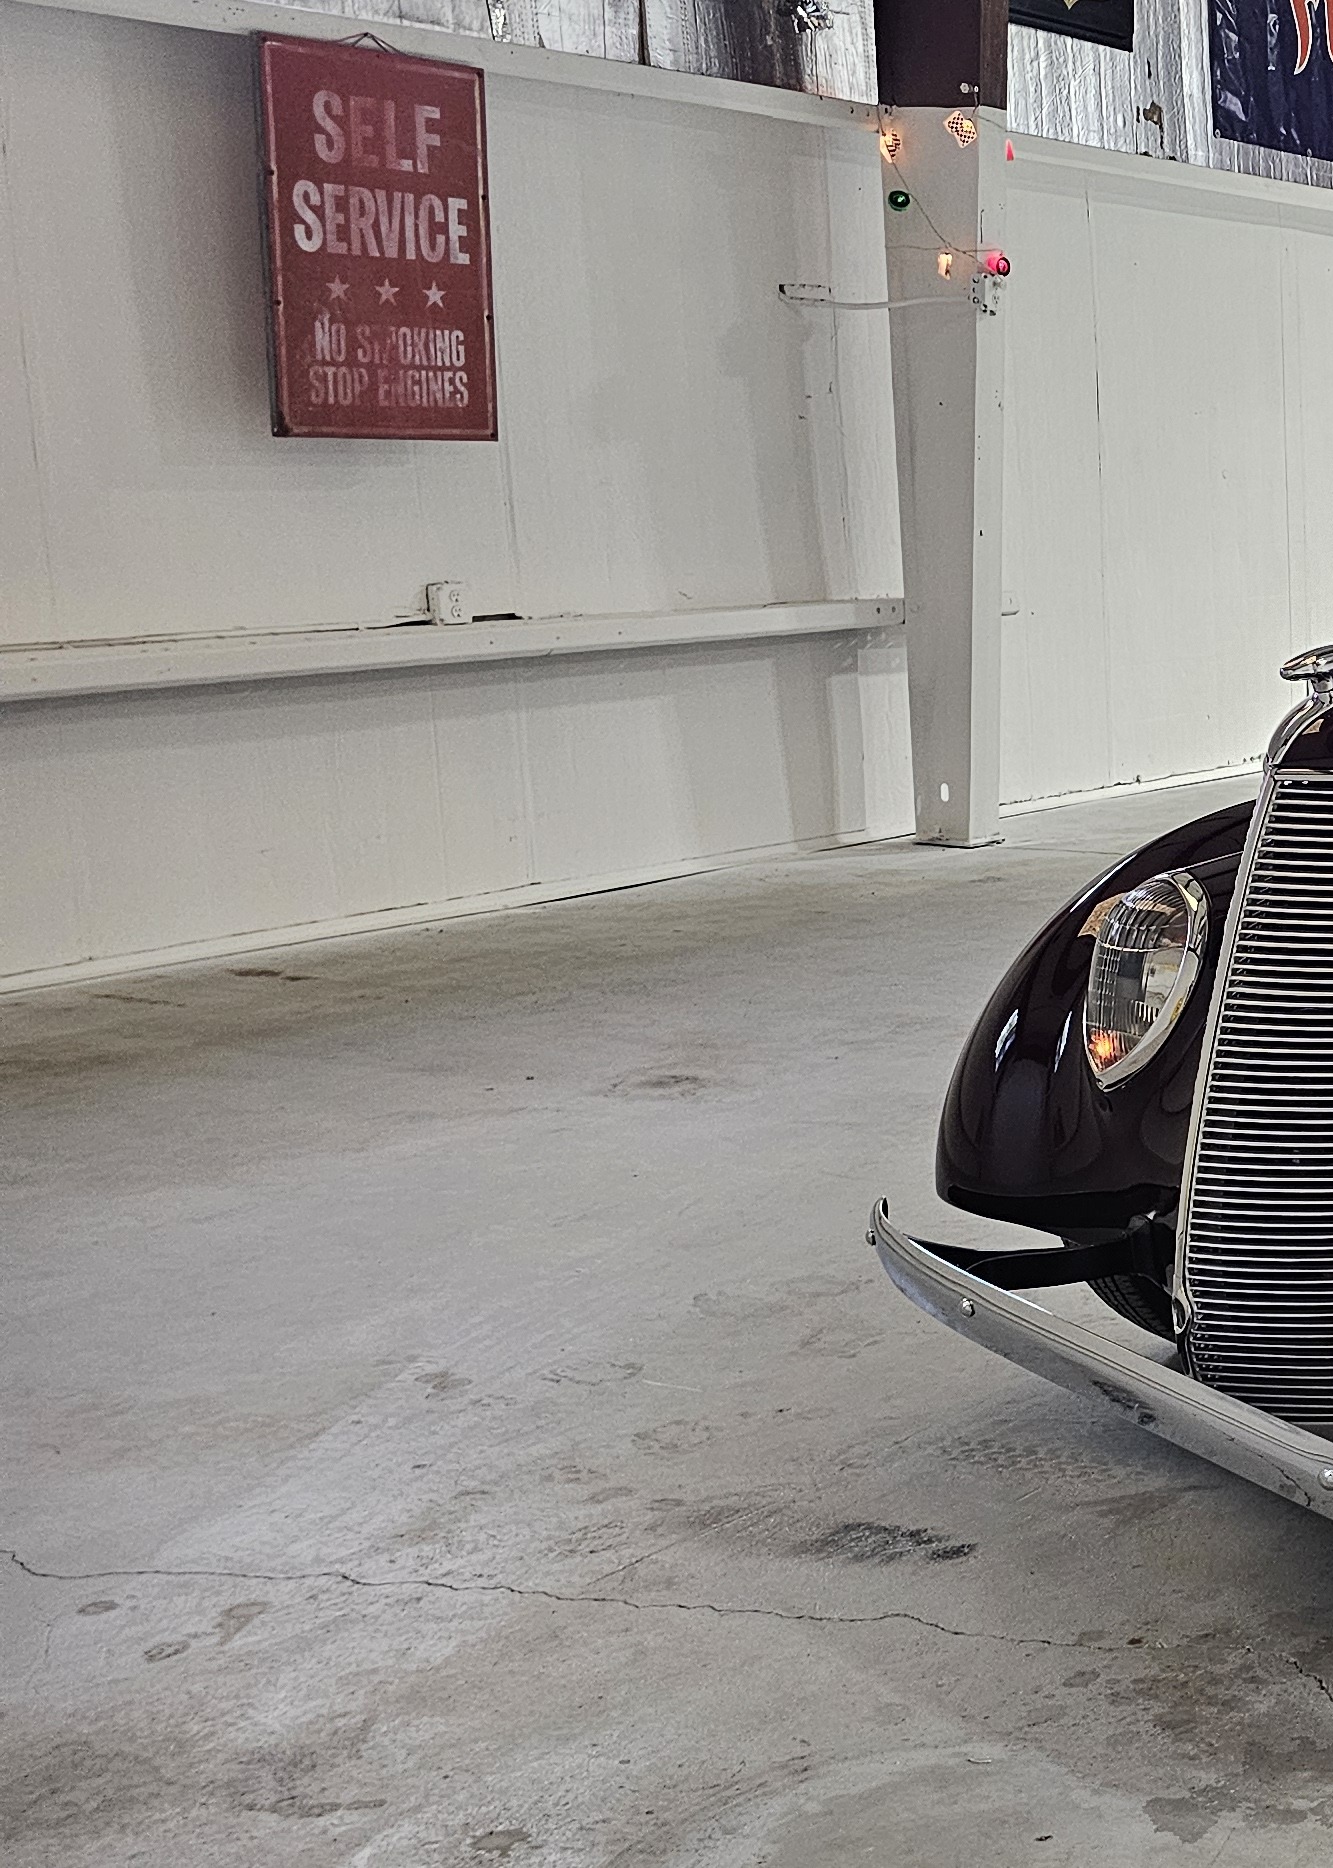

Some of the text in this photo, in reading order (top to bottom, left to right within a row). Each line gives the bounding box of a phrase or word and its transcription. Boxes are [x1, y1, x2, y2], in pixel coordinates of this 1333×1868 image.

[312, 89, 441, 174] SELF
[292, 179, 471, 265] SERVICE
[314, 313, 347, 362] NO
[309, 365, 469, 408] STOP ENGINES
